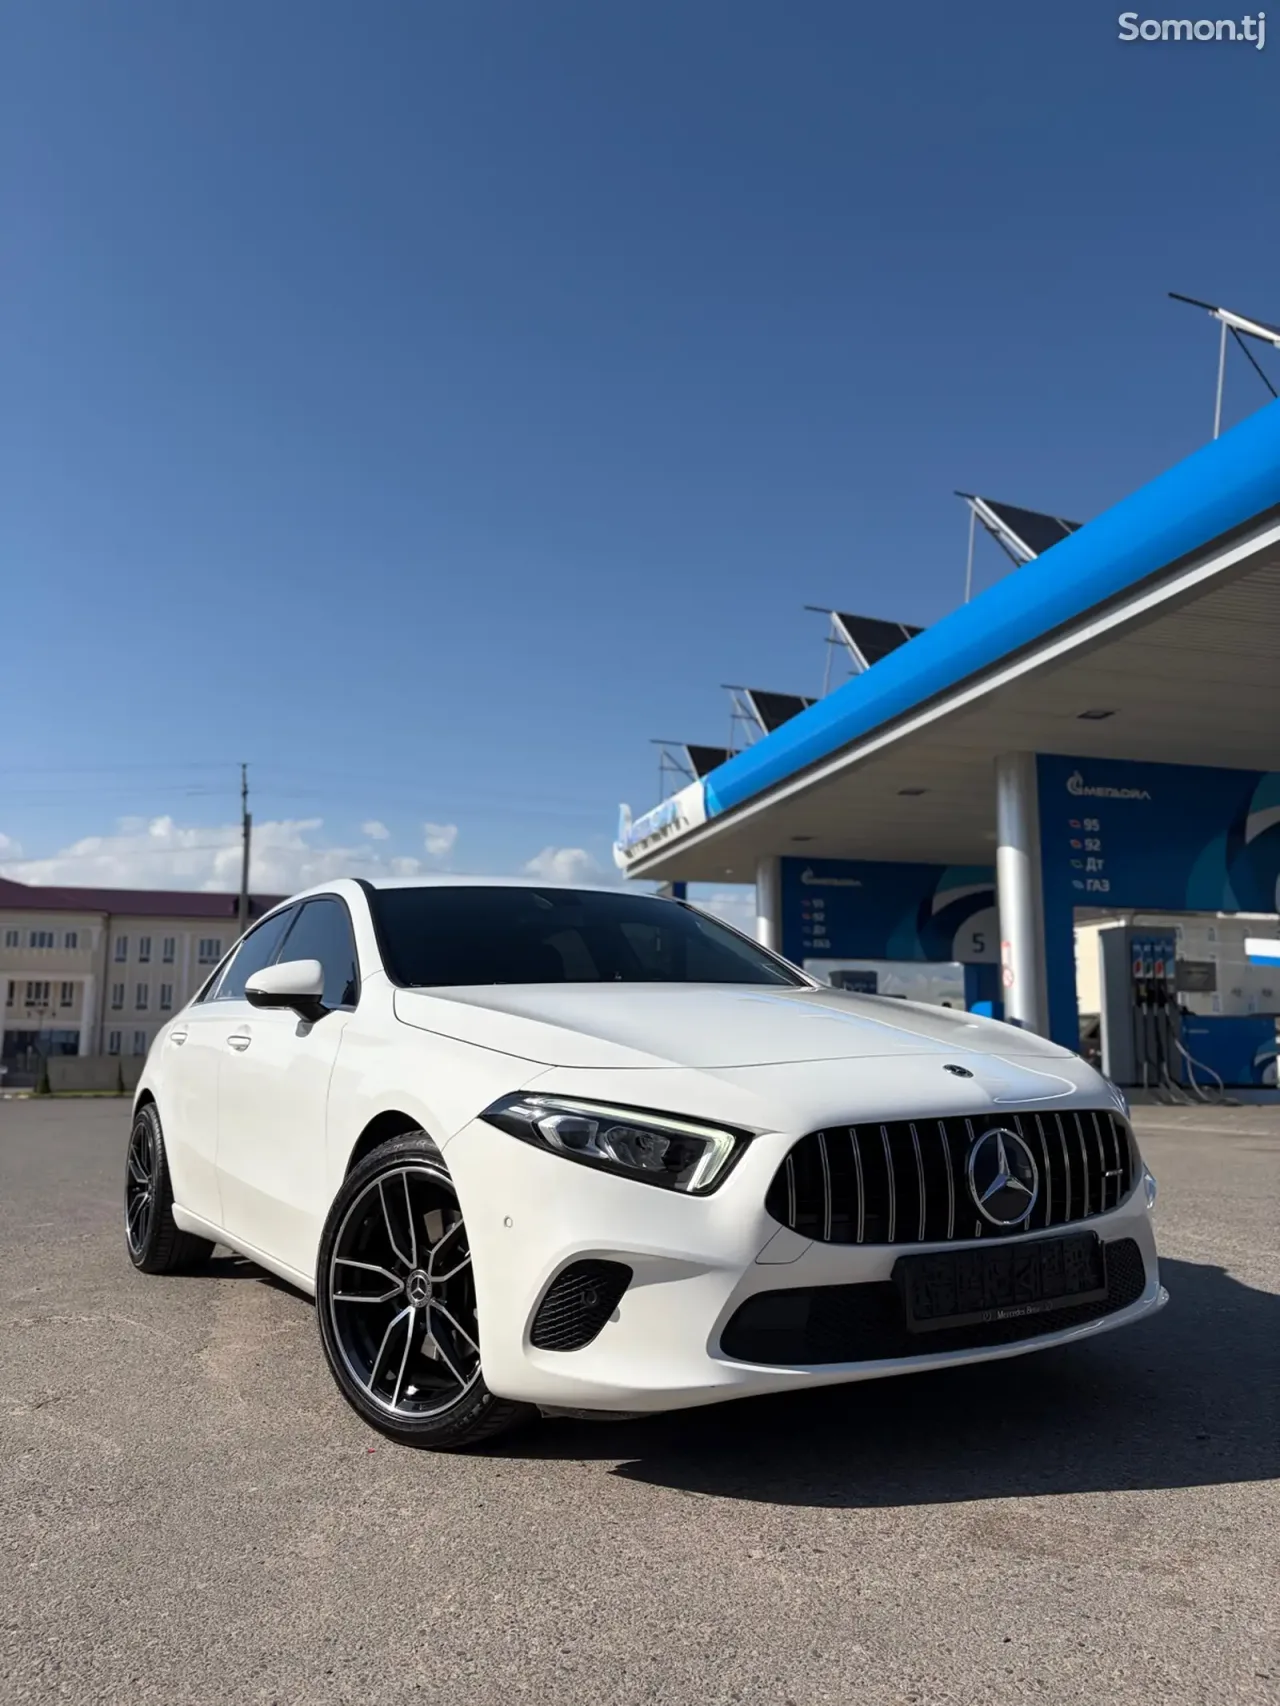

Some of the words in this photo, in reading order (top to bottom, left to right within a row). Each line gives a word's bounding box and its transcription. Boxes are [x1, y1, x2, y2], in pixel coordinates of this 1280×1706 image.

[1083, 818, 1100, 831] 95
[1084, 838, 1101, 851] 92
[1086, 879, 1110, 892] ГАЗ
[972, 932, 985, 953] 5
